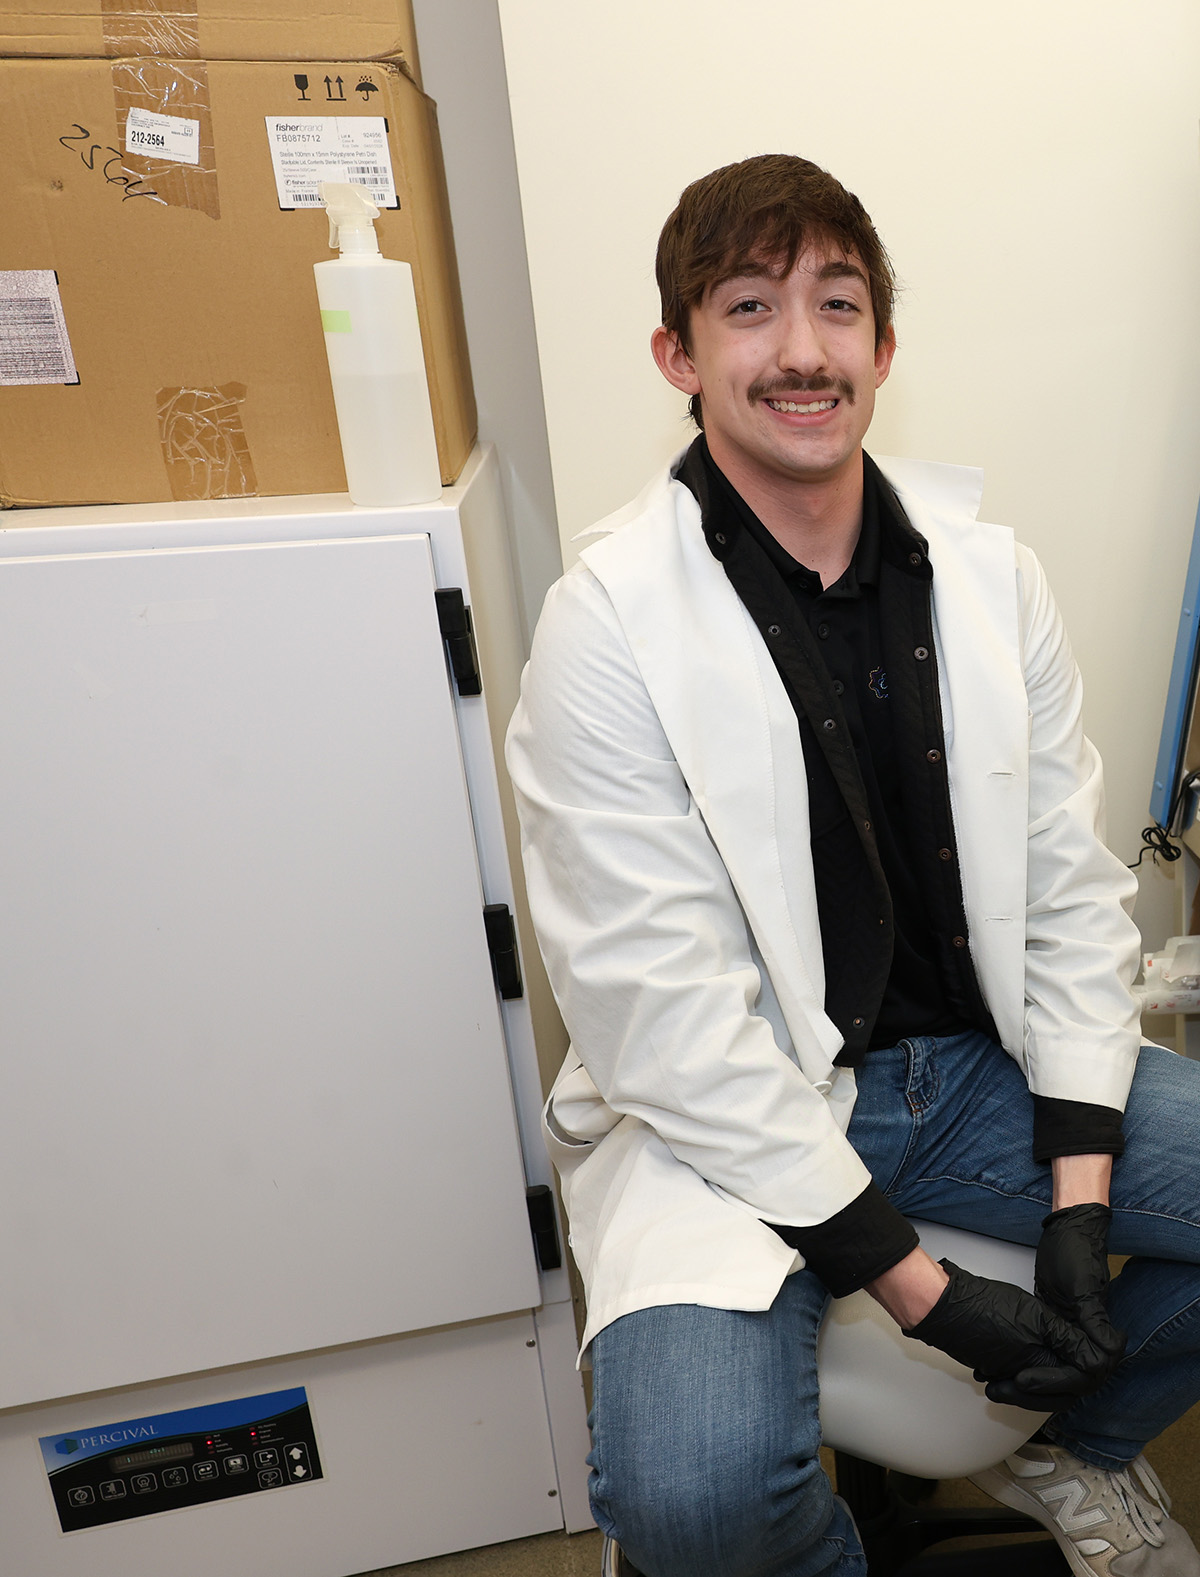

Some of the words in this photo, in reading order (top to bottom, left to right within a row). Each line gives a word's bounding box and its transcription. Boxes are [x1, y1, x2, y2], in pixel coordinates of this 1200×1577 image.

[275, 123, 323, 132] fisherbrand
[131, 130, 165, 147] 212-2564
[275, 134, 321, 143] FB0875712
[81, 1424, 159, 1449] PERCIVAL
